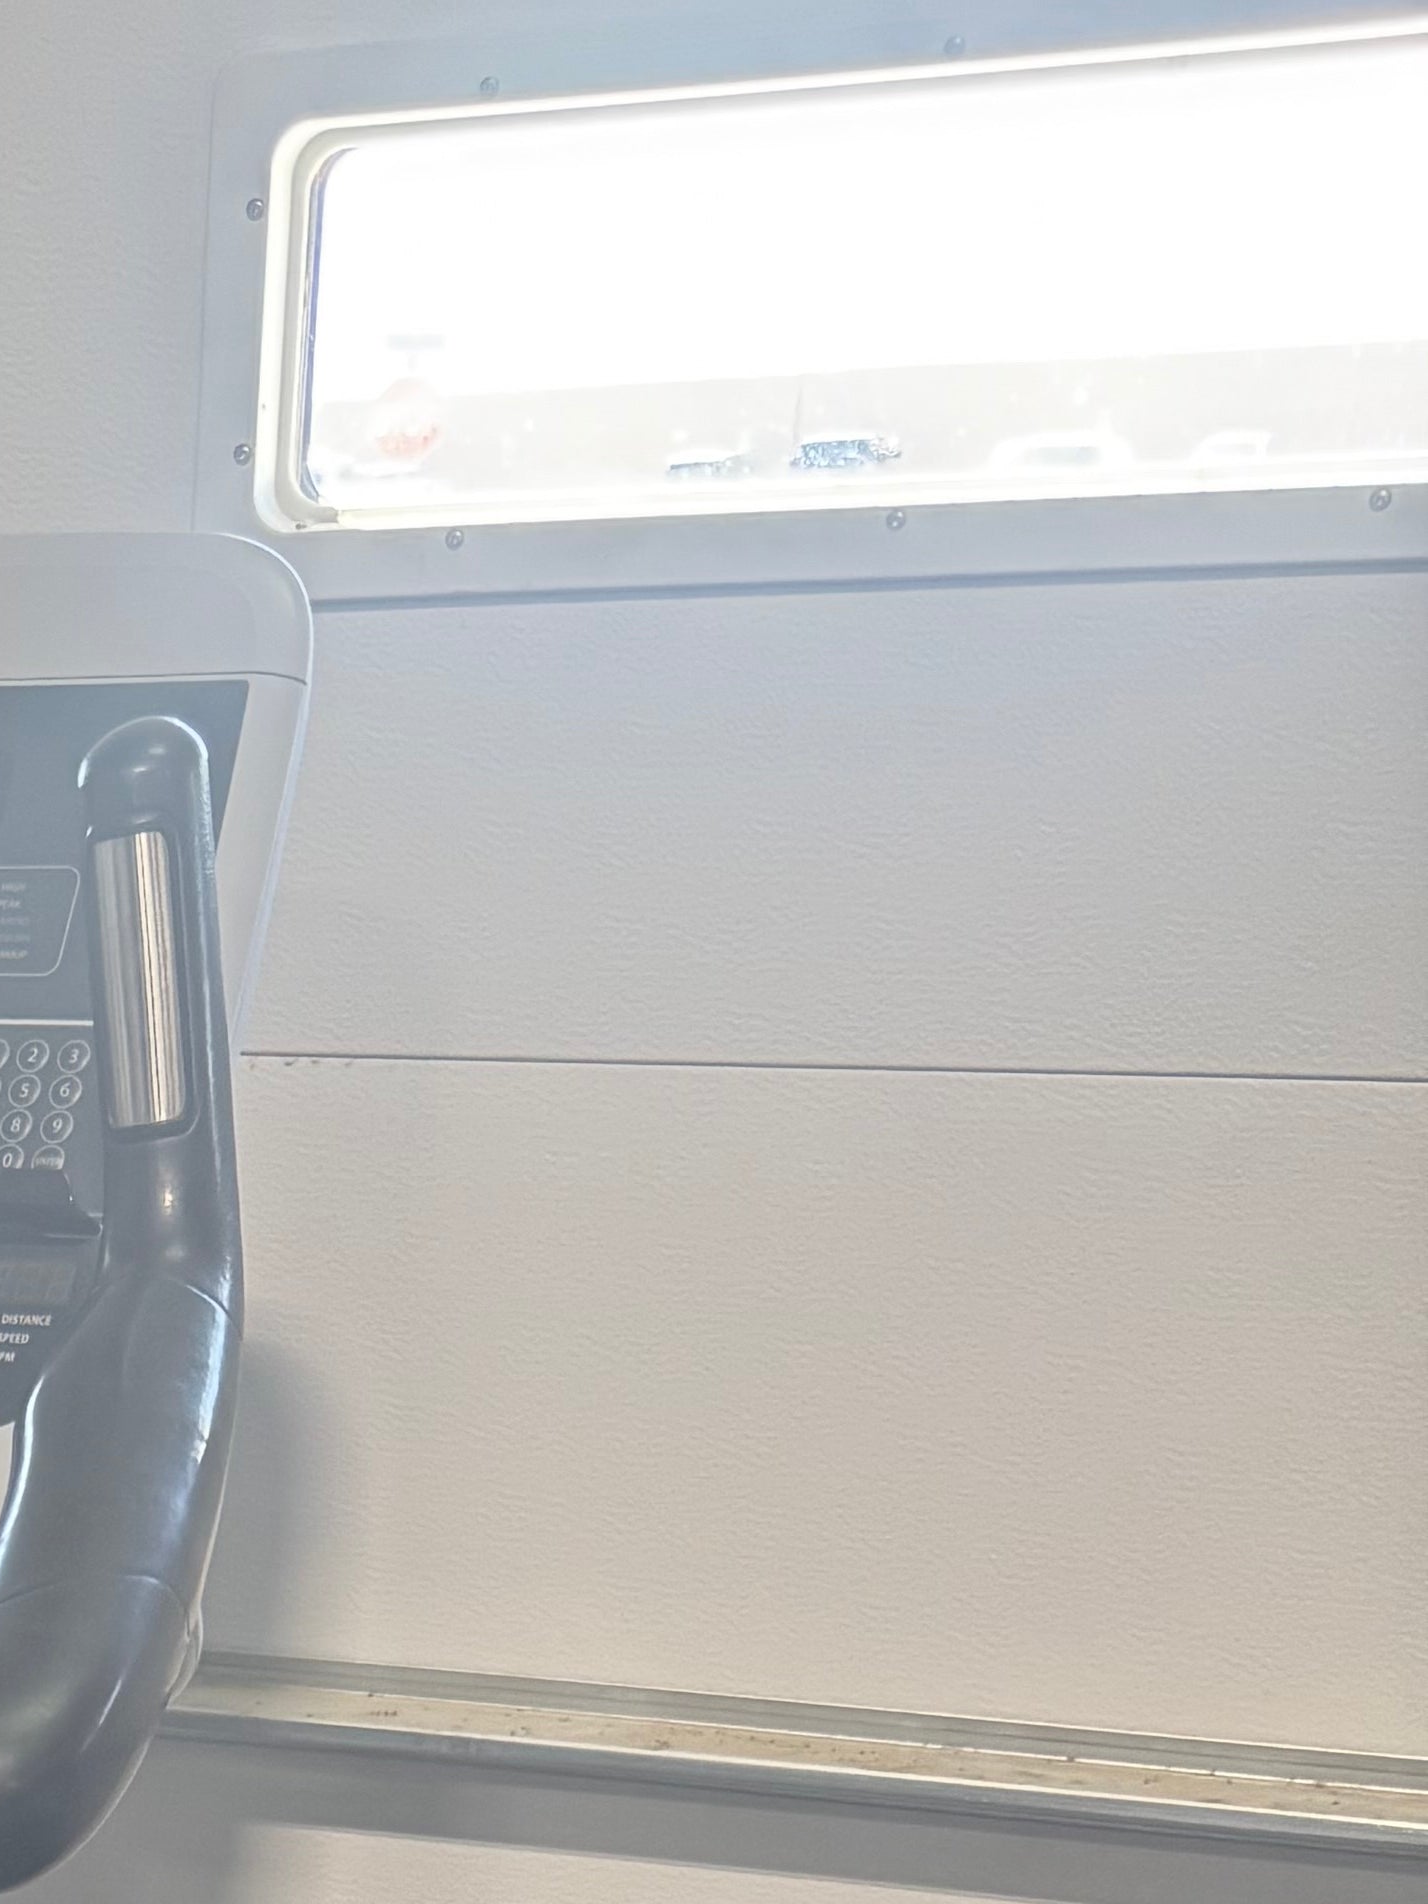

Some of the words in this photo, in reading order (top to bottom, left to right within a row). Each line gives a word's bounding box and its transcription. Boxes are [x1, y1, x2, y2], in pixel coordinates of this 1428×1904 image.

[27, 1048, 38, 1062] 2
[68, 1049, 79, 1063] 3
[19, 1083, 30, 1098] 5
[59, 1083, 70, 1097] 6
[10, 1118, 21, 1132] 8
[52, 1118, 63, 1133] 9
[2, 1154, 13, 1168] 0
[1, 1314, 52, 1327] DISTANCE
